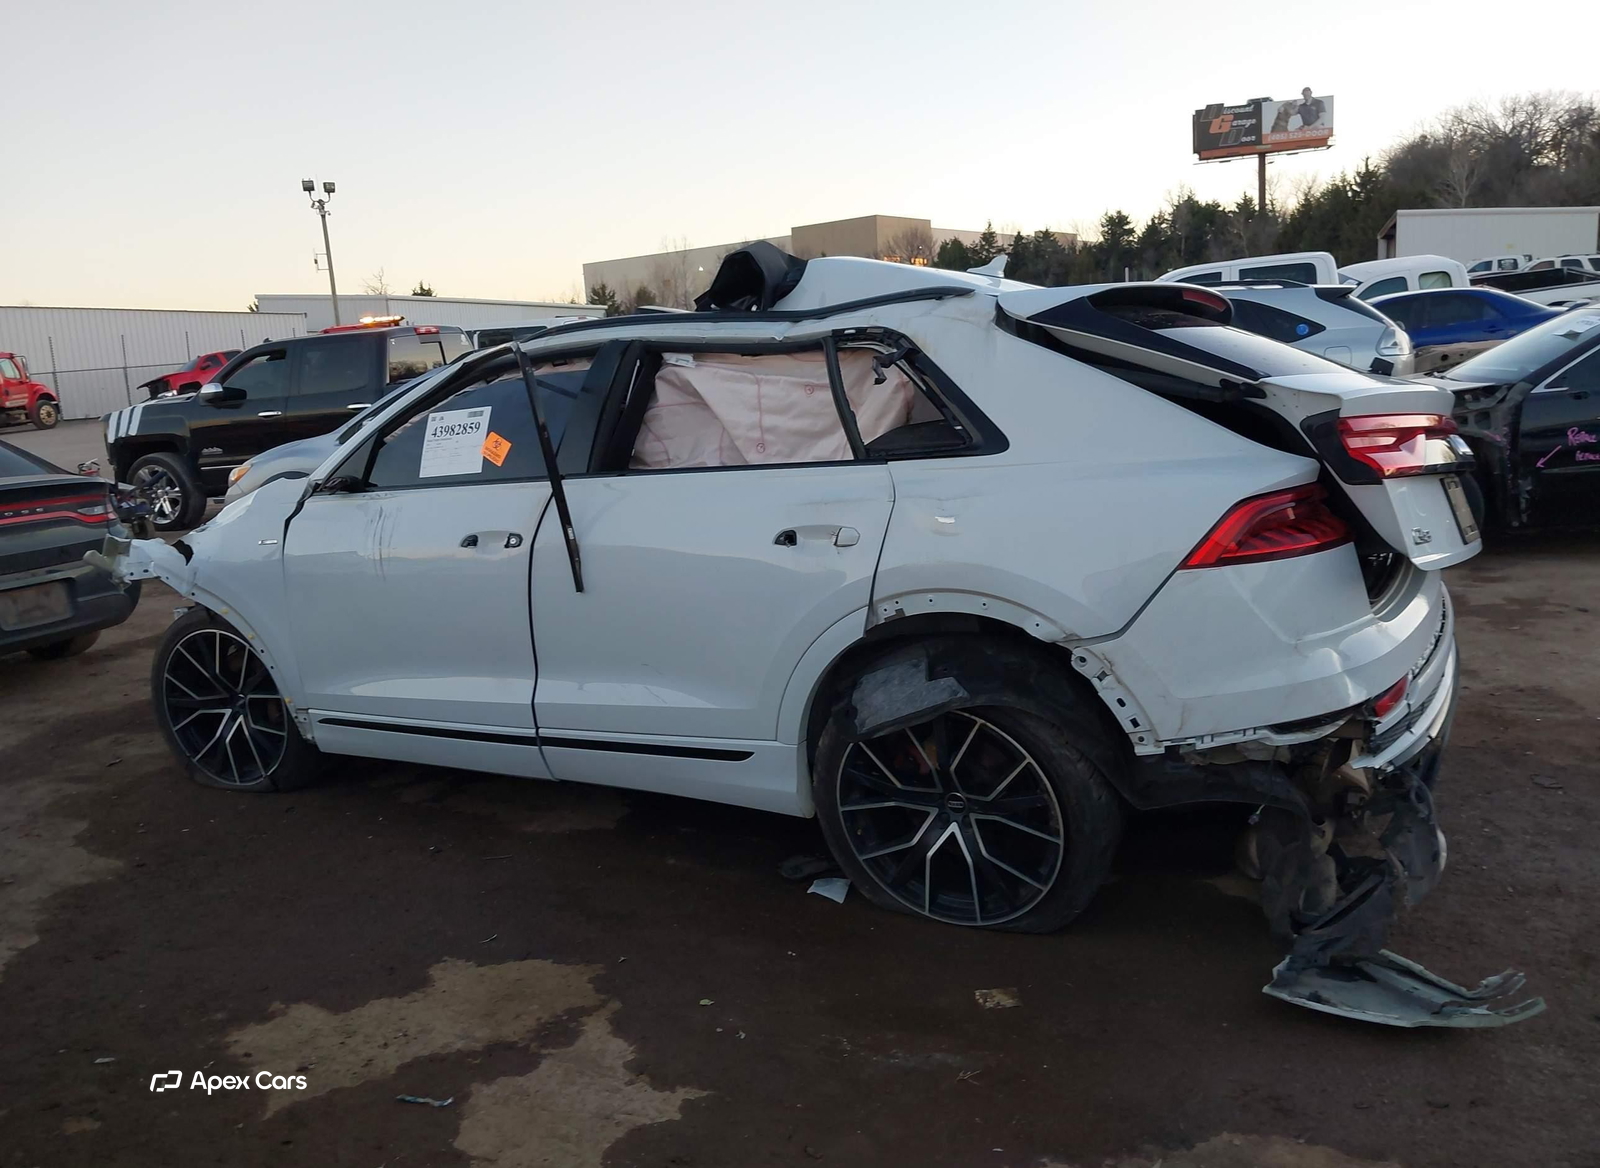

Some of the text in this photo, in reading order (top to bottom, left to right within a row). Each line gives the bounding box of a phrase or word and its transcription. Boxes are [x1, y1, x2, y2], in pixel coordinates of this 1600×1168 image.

[1209, 115, 1256, 133] Garage
[1219, 128, 1256, 147] Door
[431, 421, 481, 438] 43982859
